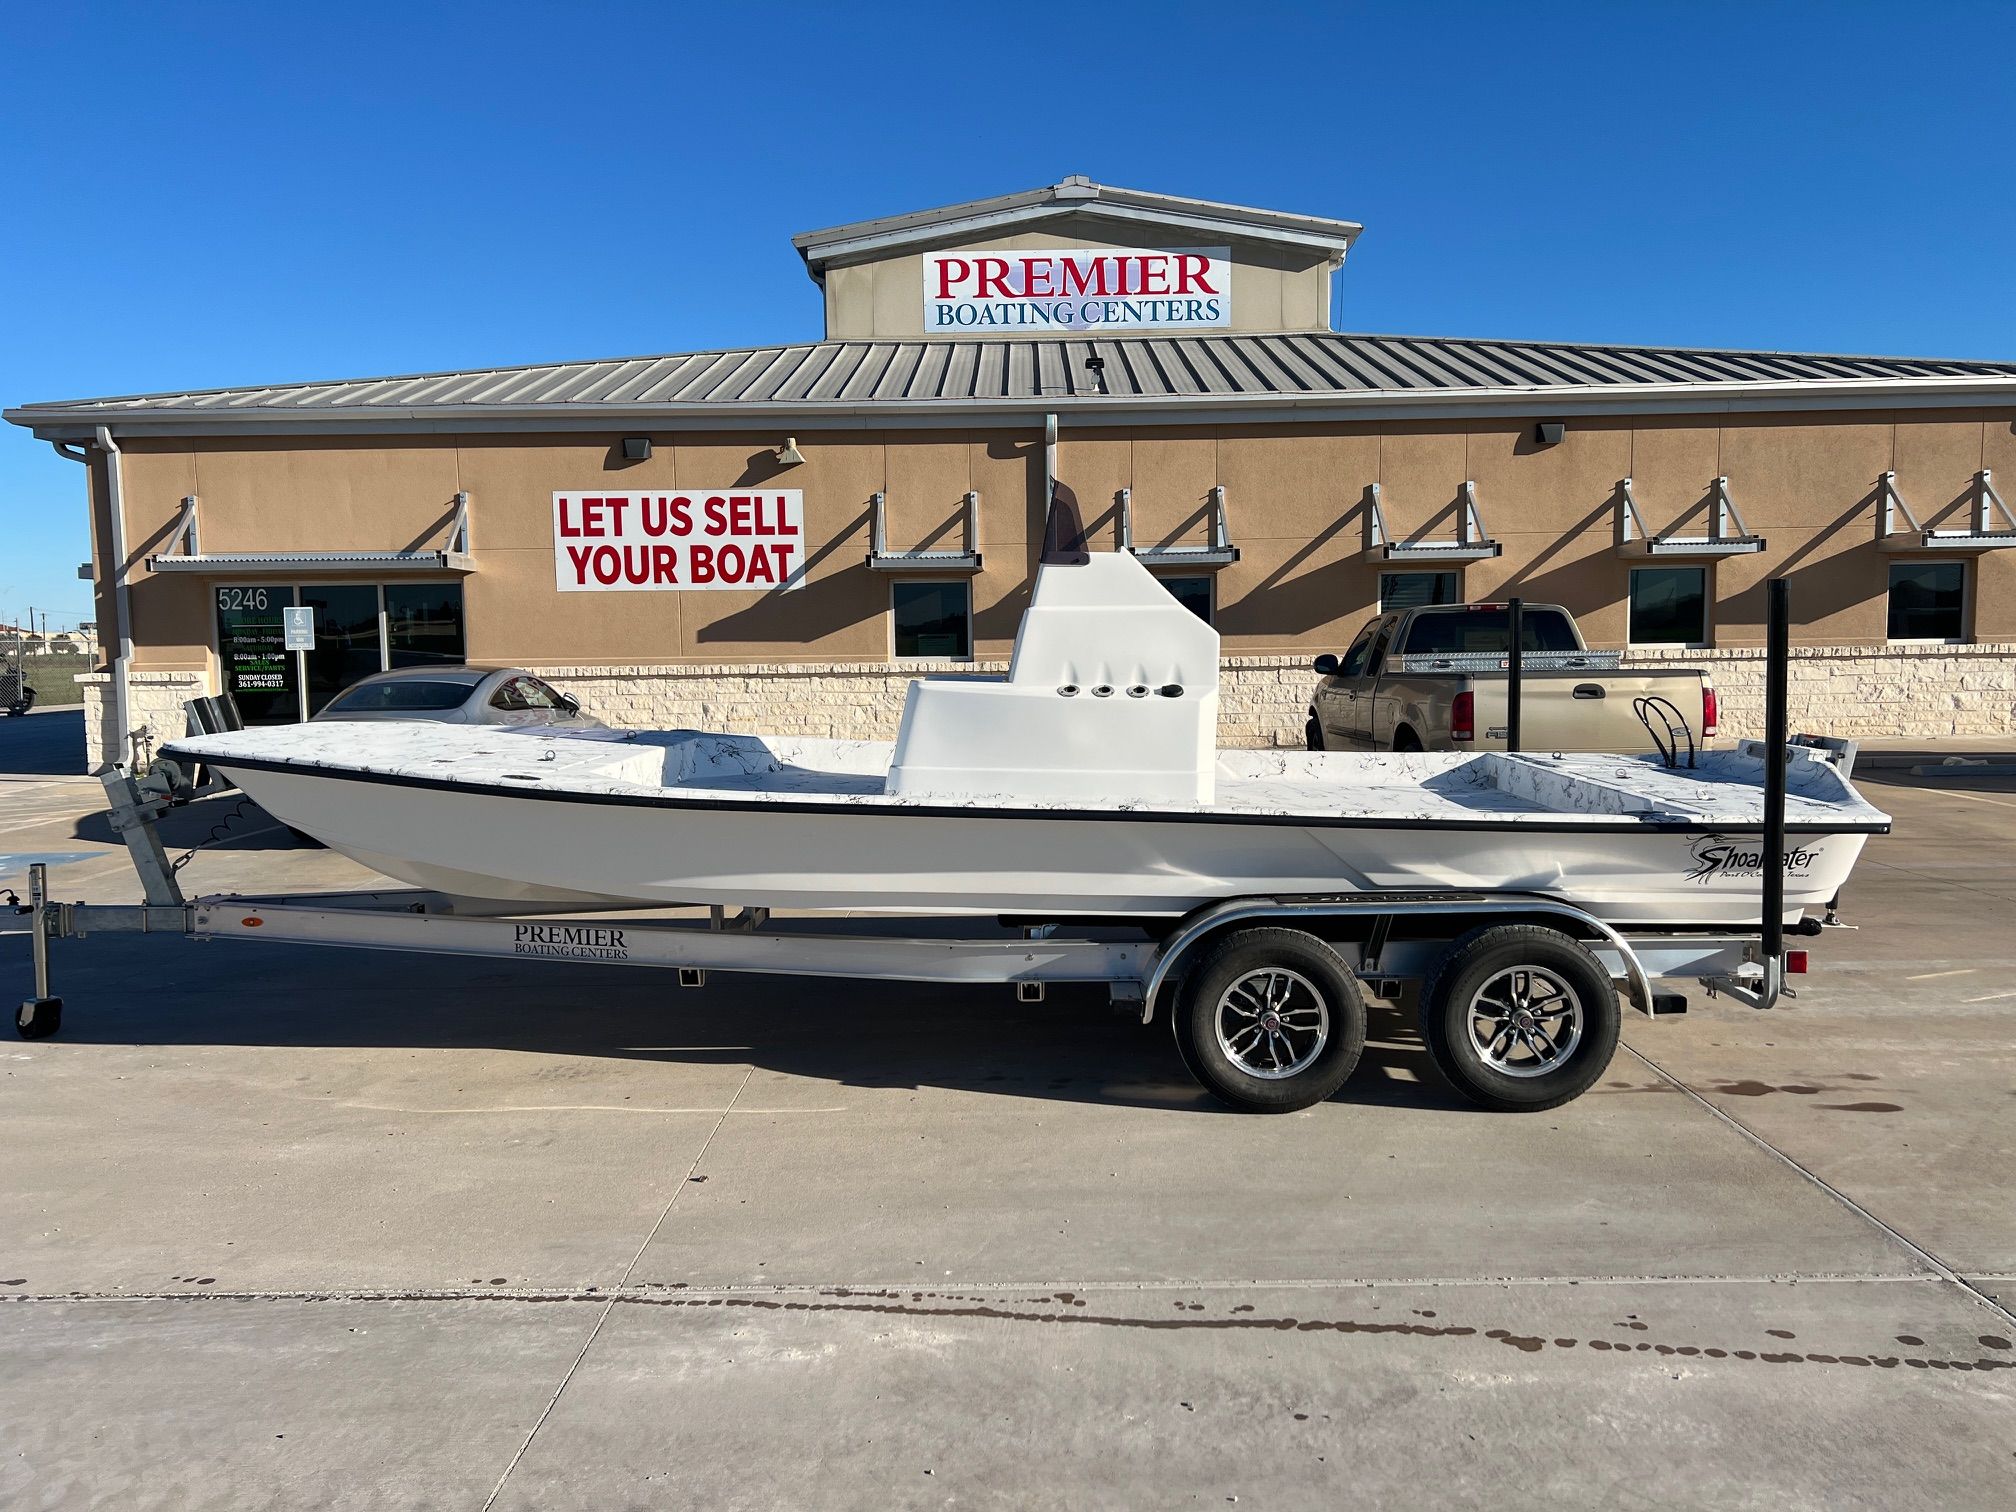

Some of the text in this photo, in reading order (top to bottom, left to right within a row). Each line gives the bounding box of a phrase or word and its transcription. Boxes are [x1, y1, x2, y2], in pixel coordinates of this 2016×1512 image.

[934, 254, 1219, 299] PREMIER
[936, 299, 1220, 326] BOATING CENTERS
[559, 496, 798, 537] LET US SELL
[566, 544, 794, 585] YOUR BOAT
[219, 588, 268, 610] 5246
[514, 925, 628, 948] PREMIER
[514, 943, 628, 959] BOATING CENTERS
